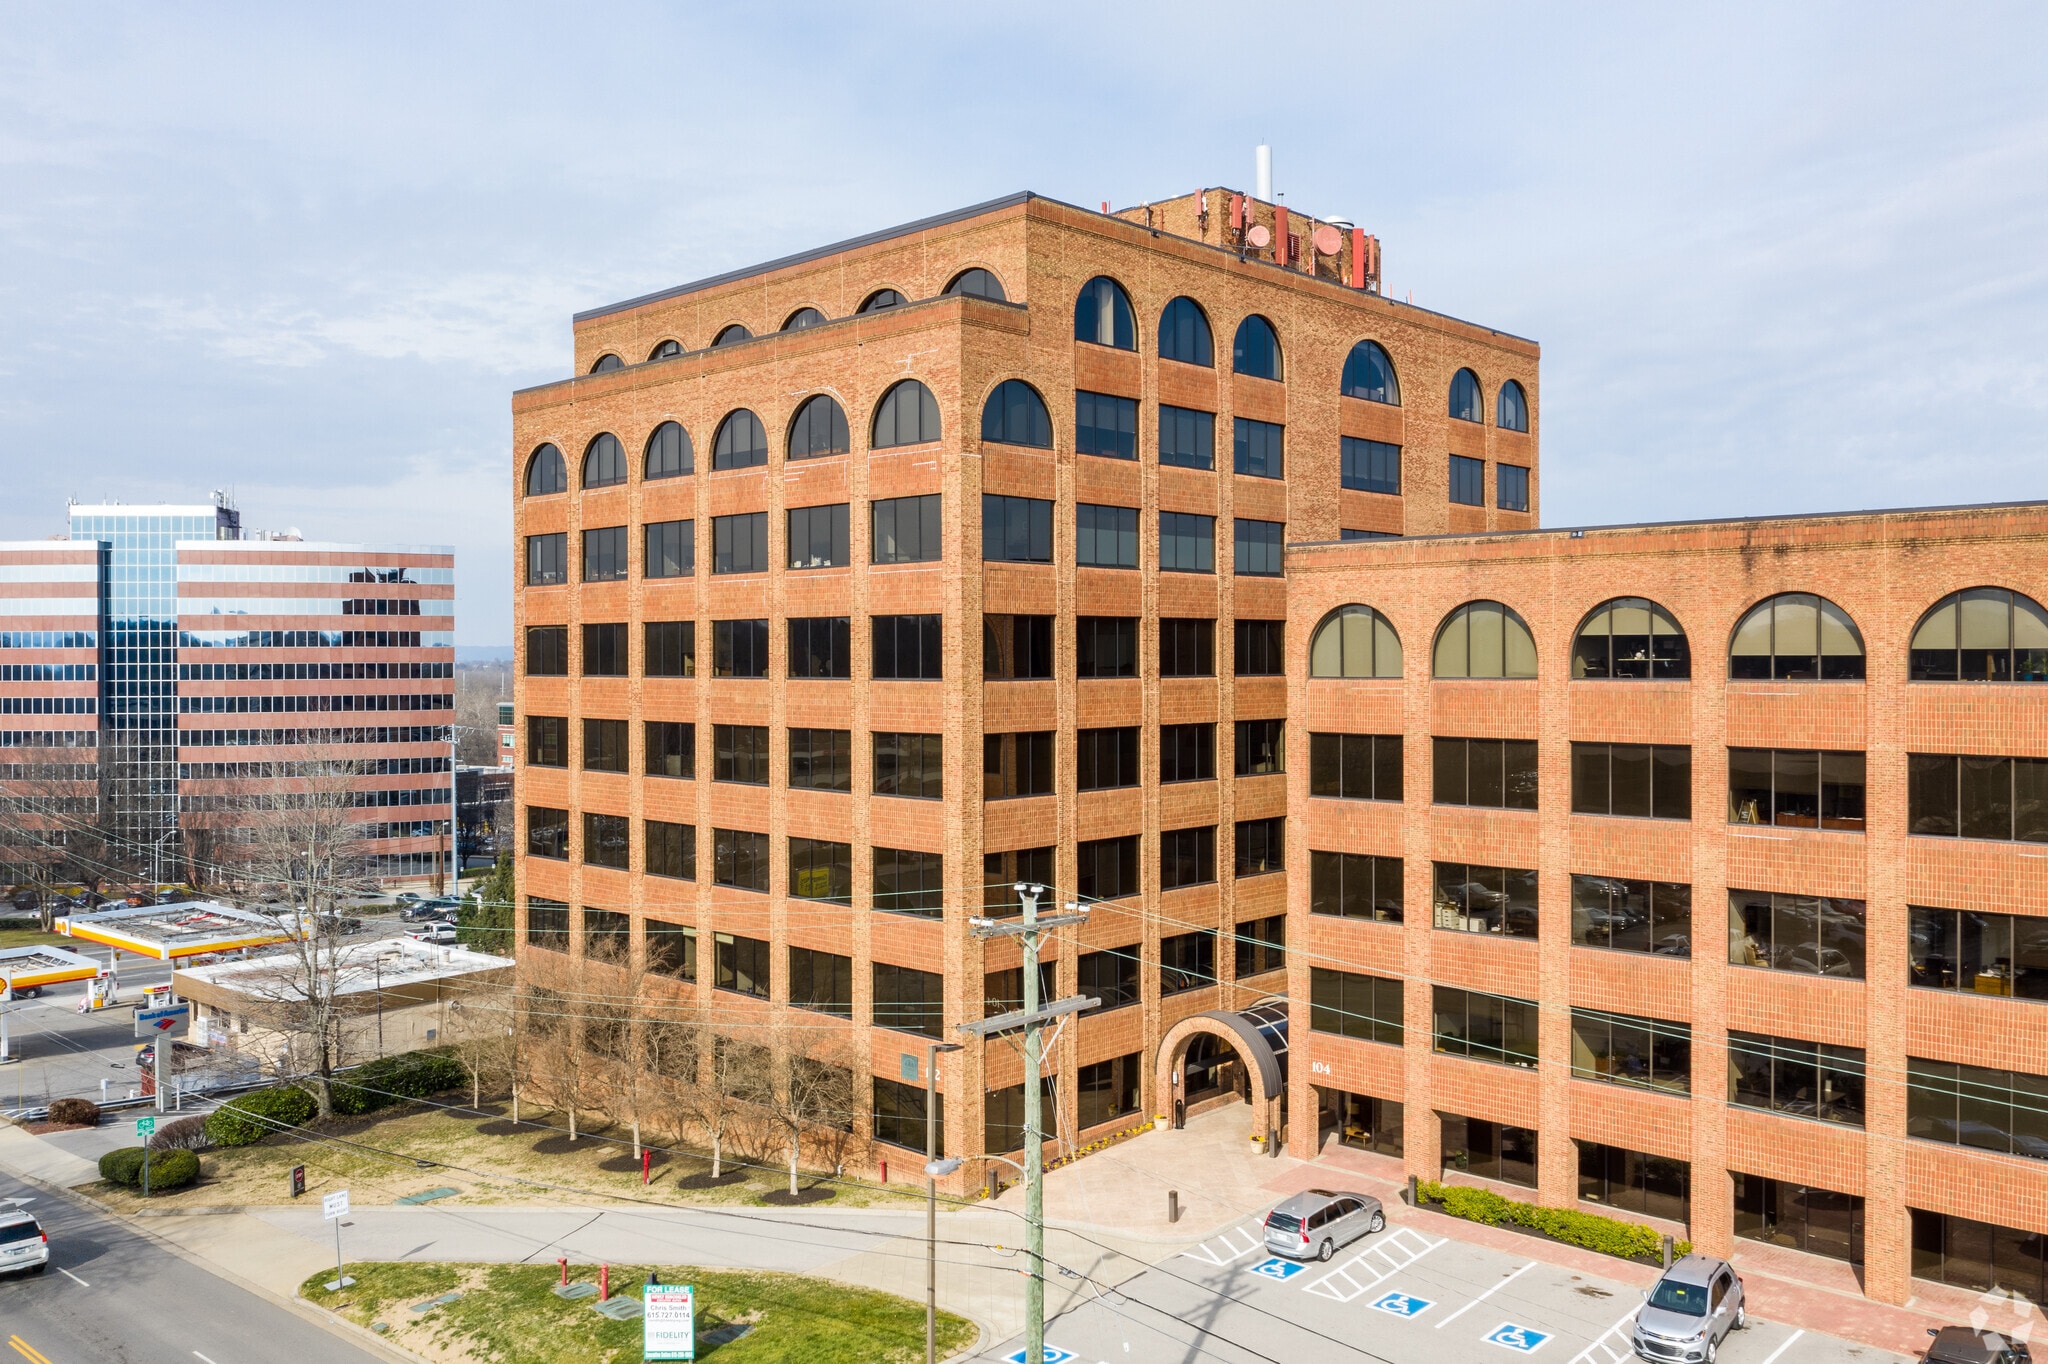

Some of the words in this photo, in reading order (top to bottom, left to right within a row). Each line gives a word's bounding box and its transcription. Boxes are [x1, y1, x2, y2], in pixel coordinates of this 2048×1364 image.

[139, 1012, 156, 1020] Bank
[925, 1067, 941, 1081] 12
[1312, 1061, 1331, 1075] 104
